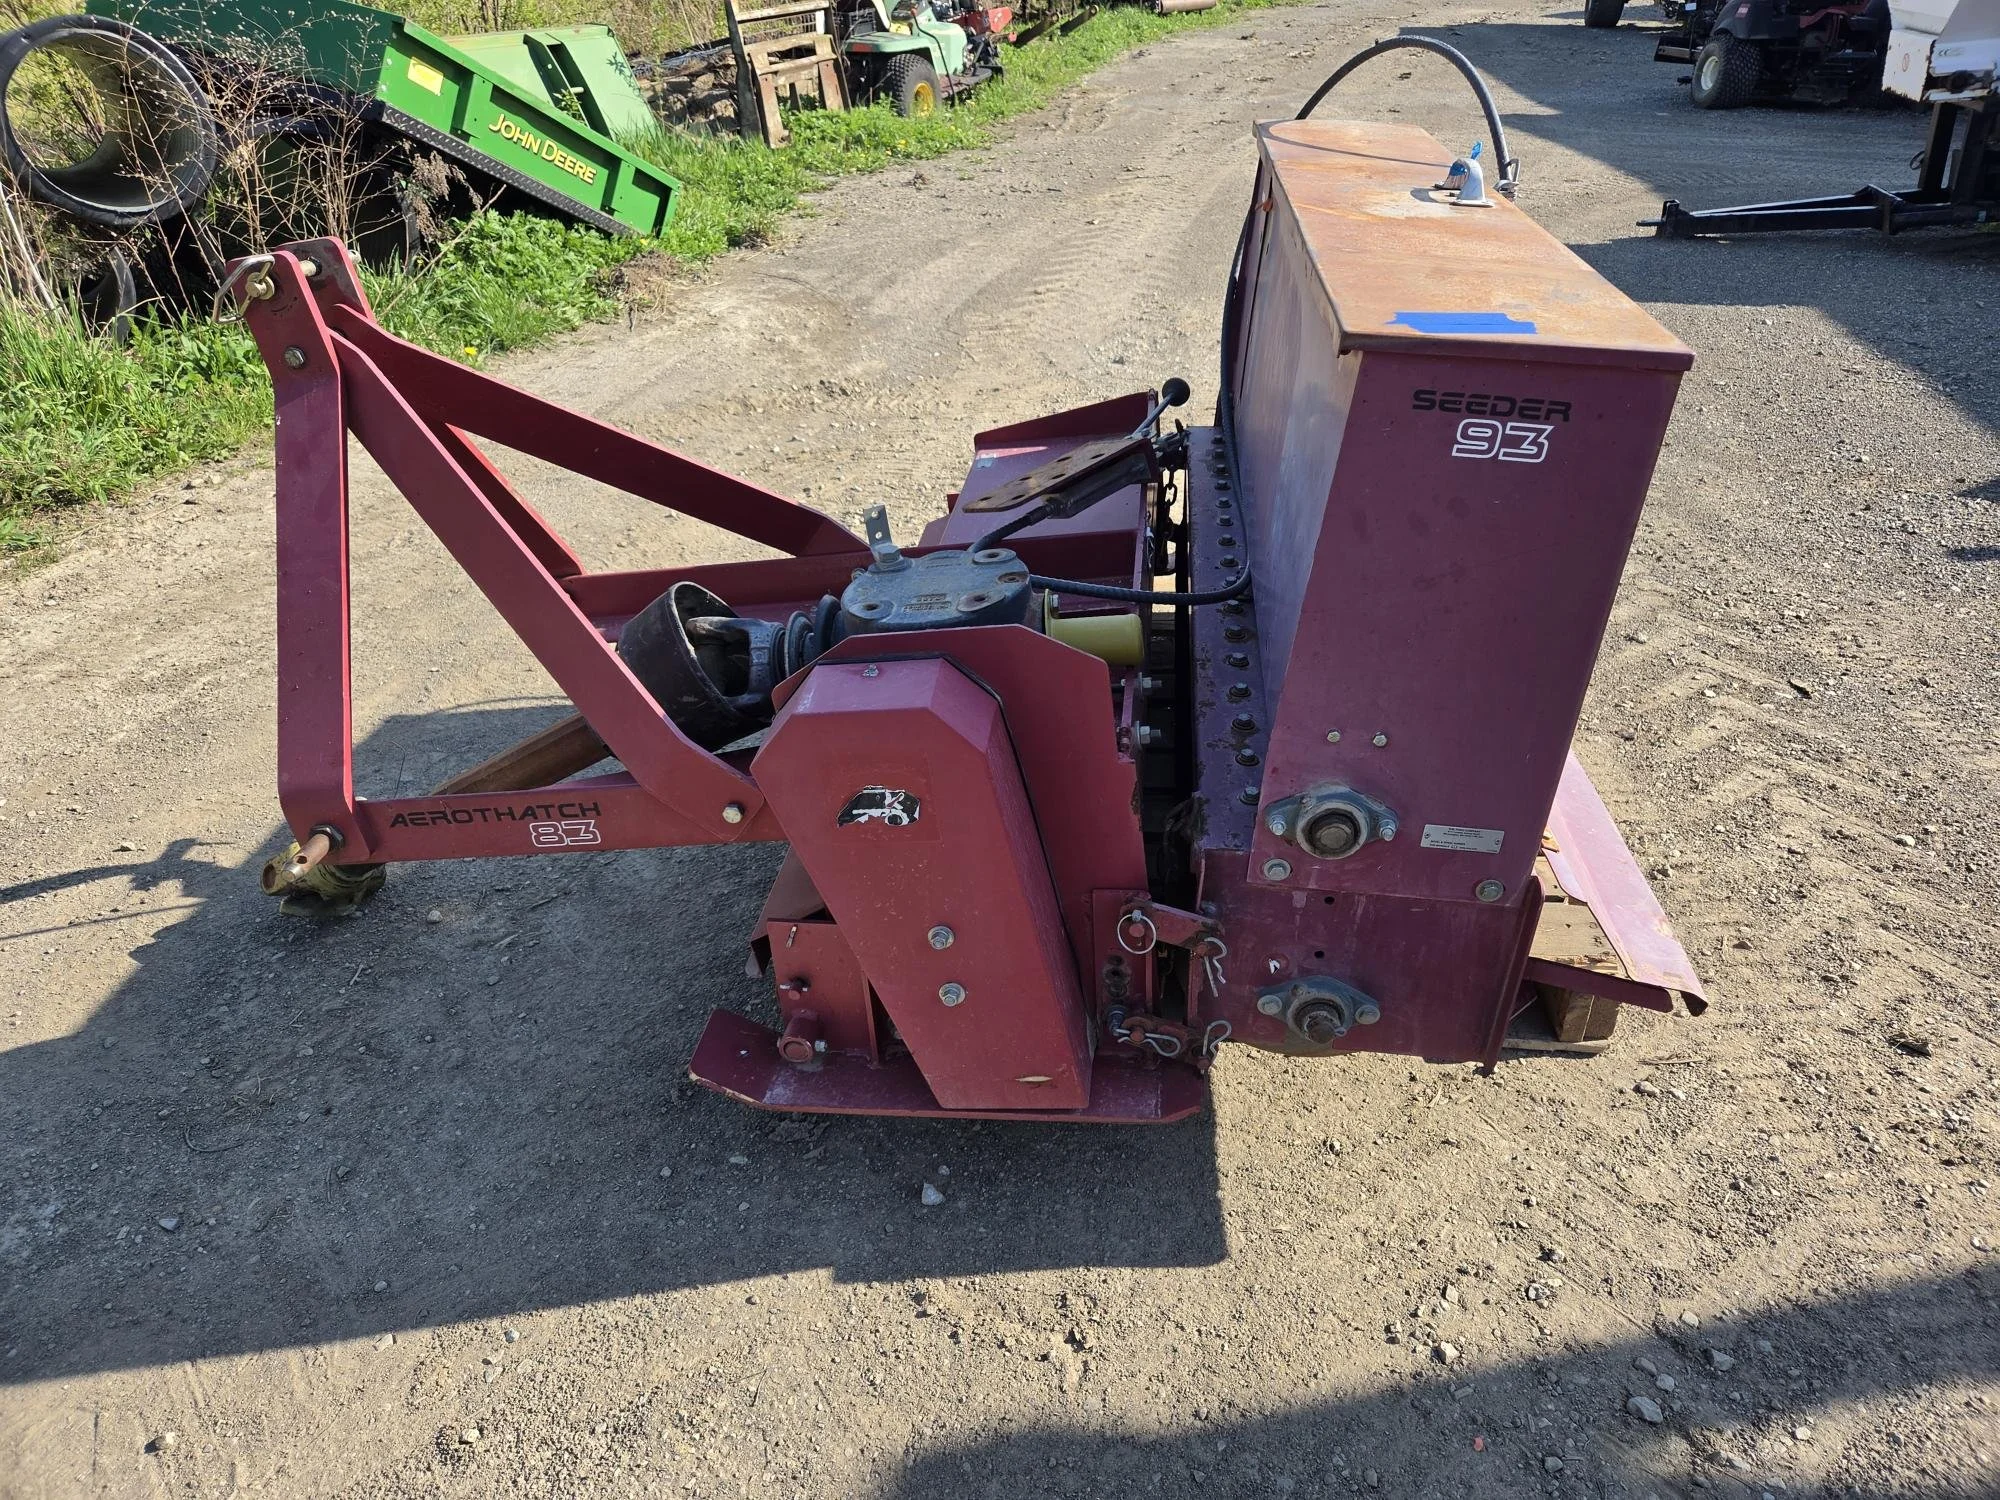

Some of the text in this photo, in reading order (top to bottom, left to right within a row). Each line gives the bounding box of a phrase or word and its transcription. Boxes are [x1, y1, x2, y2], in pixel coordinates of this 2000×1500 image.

[488, 113, 597, 184] JOHN DEERE
[1412, 388, 1573, 423] SEEDER
[1451, 418, 1555, 463] 93
[390, 801, 603, 828] AEROTHATCH
[529, 819, 602, 847] 83
